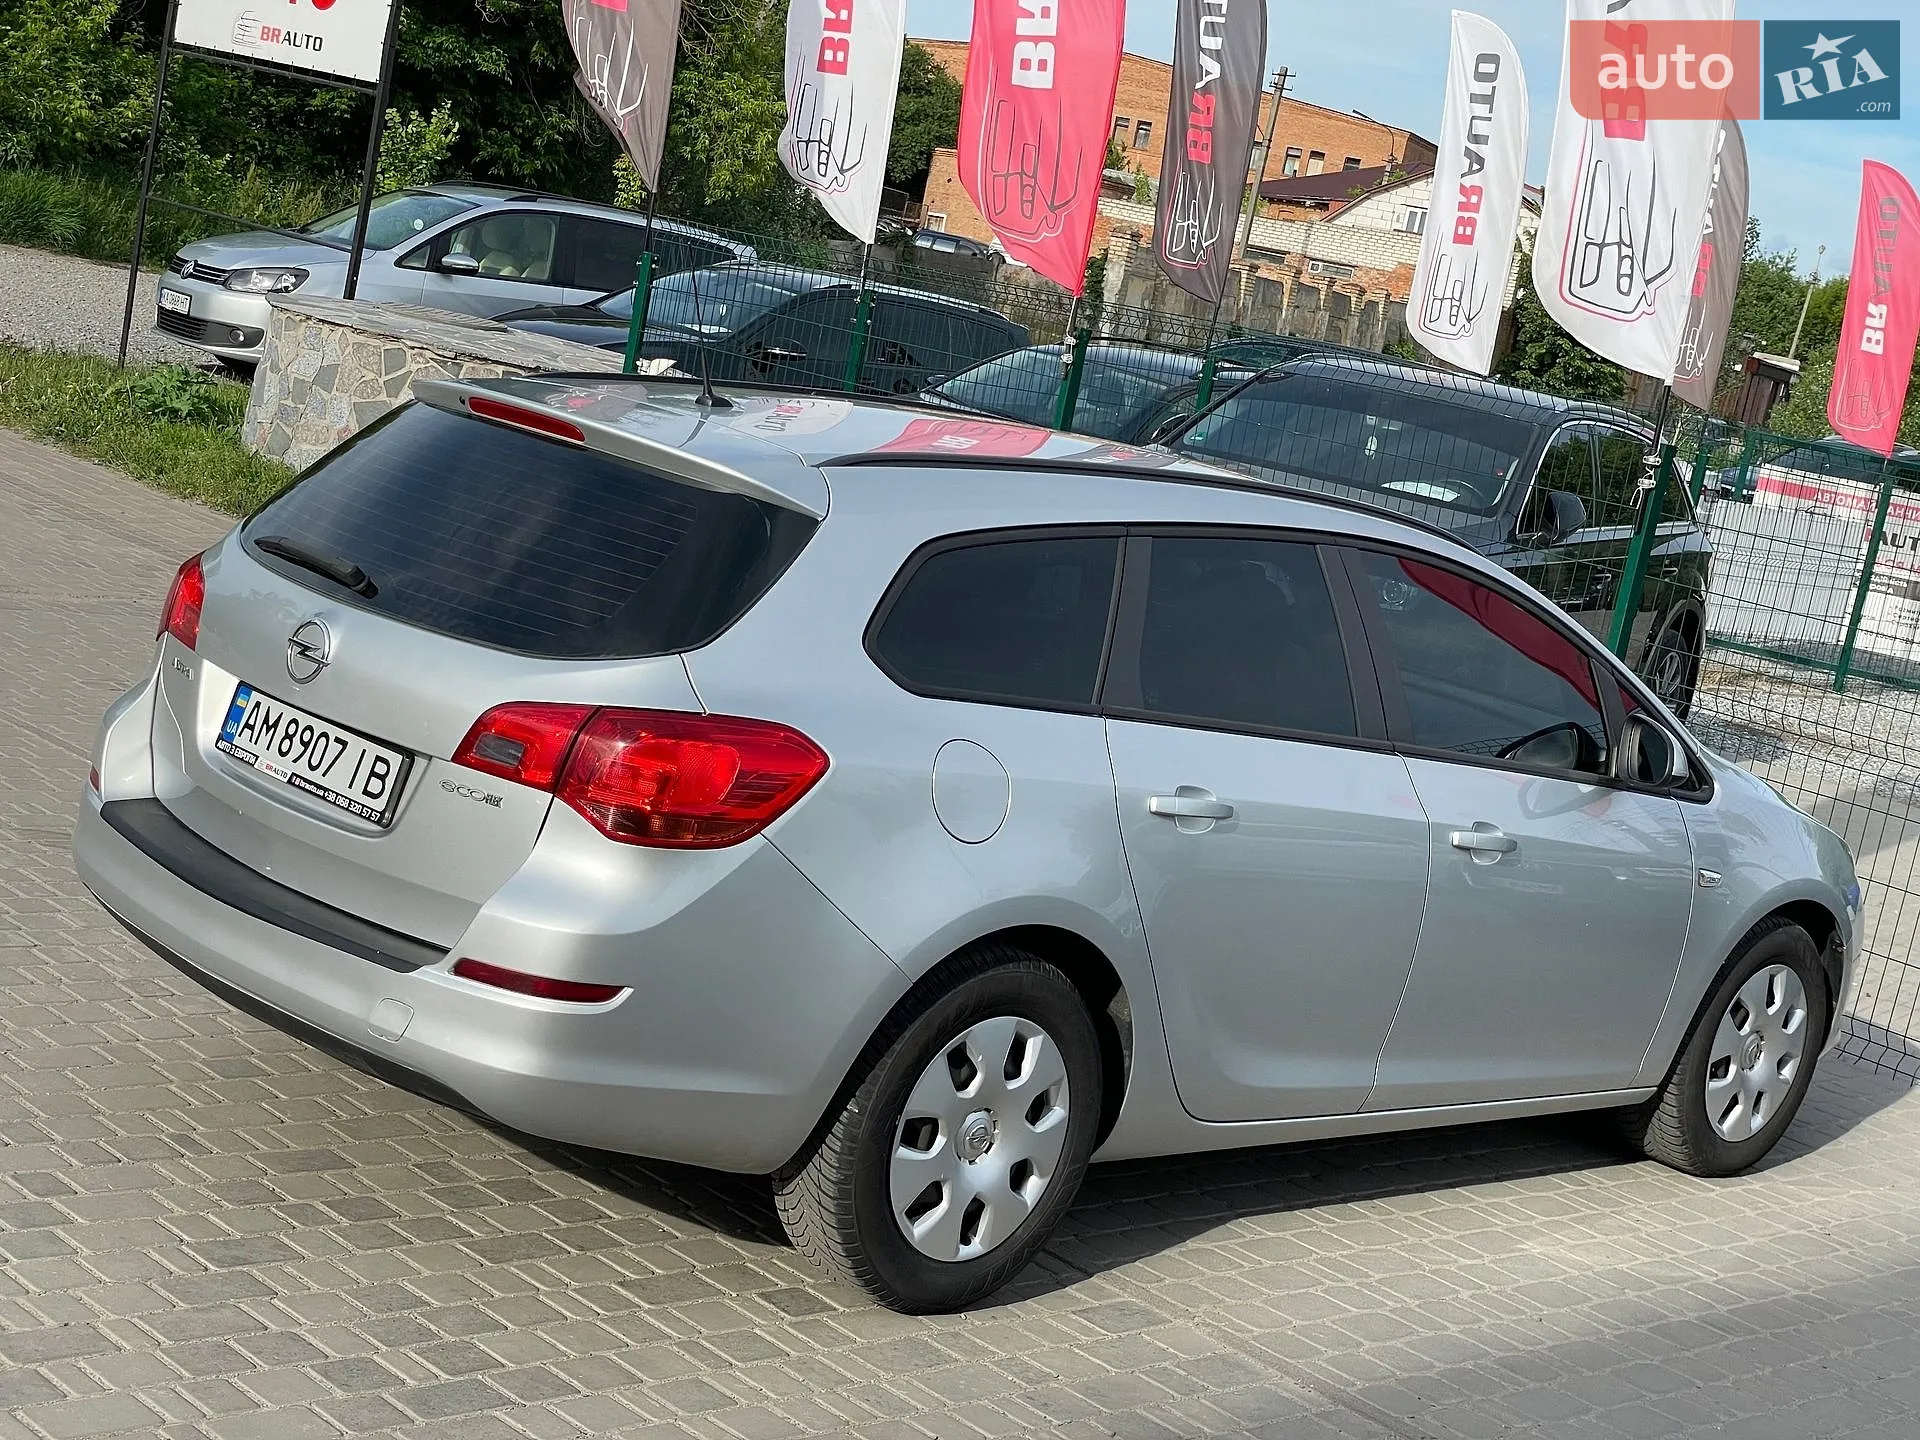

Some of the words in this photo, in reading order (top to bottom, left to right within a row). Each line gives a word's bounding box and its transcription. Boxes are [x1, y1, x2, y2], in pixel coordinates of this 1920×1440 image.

[226, 719, 238, 735] UA
[361, 806, 371, 818] 57
[370, 810, 380, 822] 57
